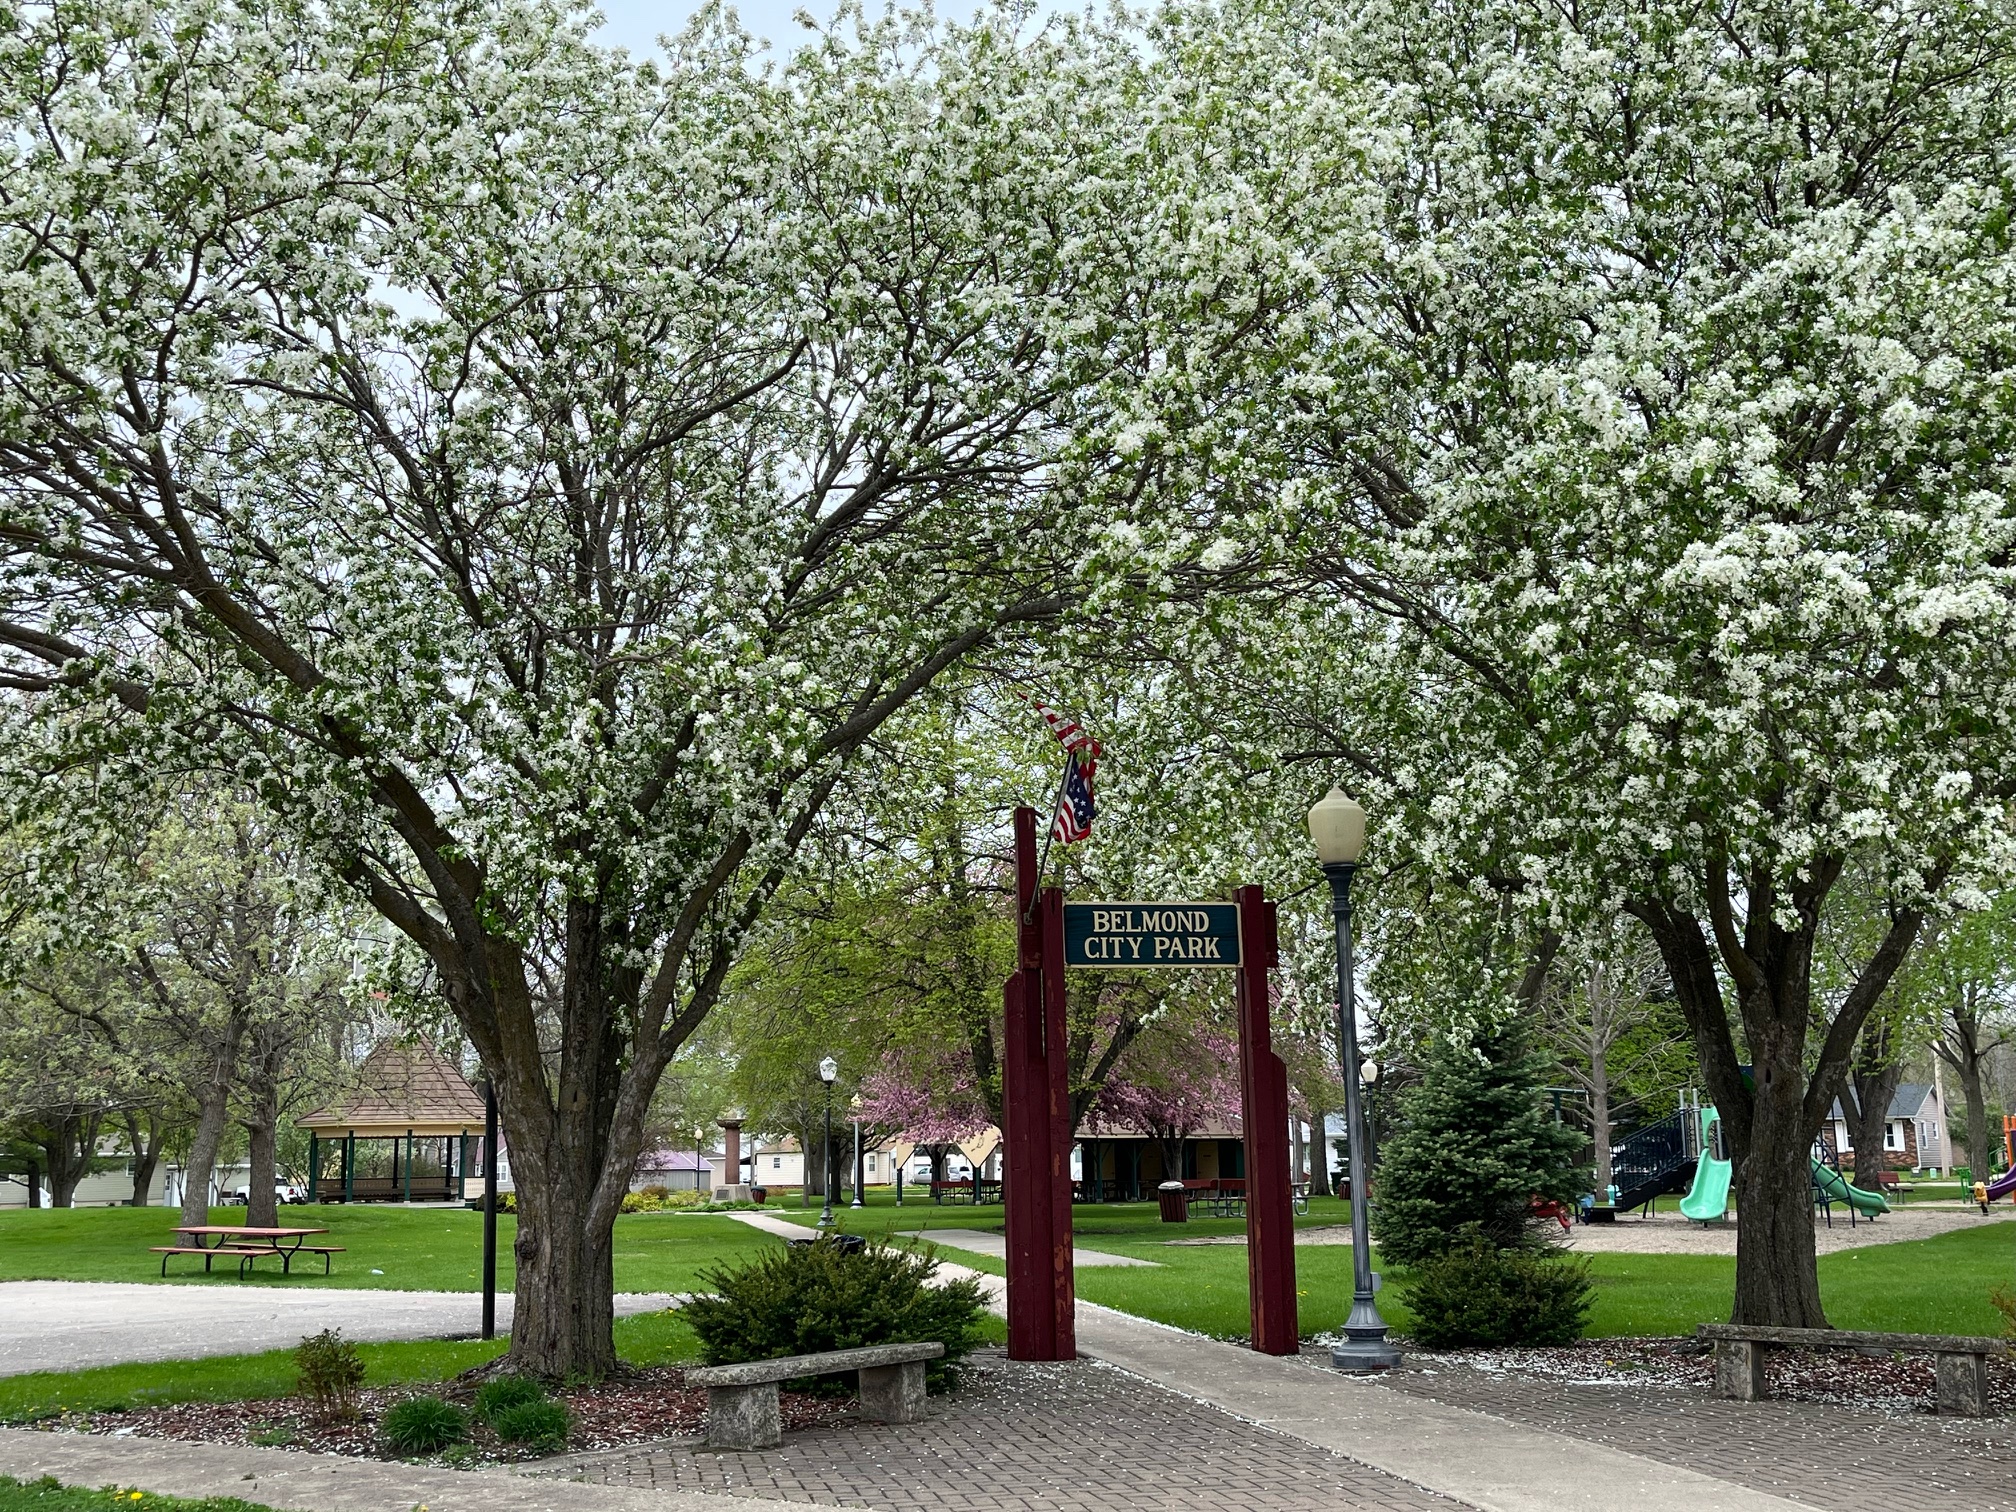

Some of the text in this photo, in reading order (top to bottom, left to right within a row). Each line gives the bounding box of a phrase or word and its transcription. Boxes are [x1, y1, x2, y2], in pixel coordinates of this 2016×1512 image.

[1092, 910, 1210, 933] BELMOND
[1084, 937, 1221, 959] CITY PARK
